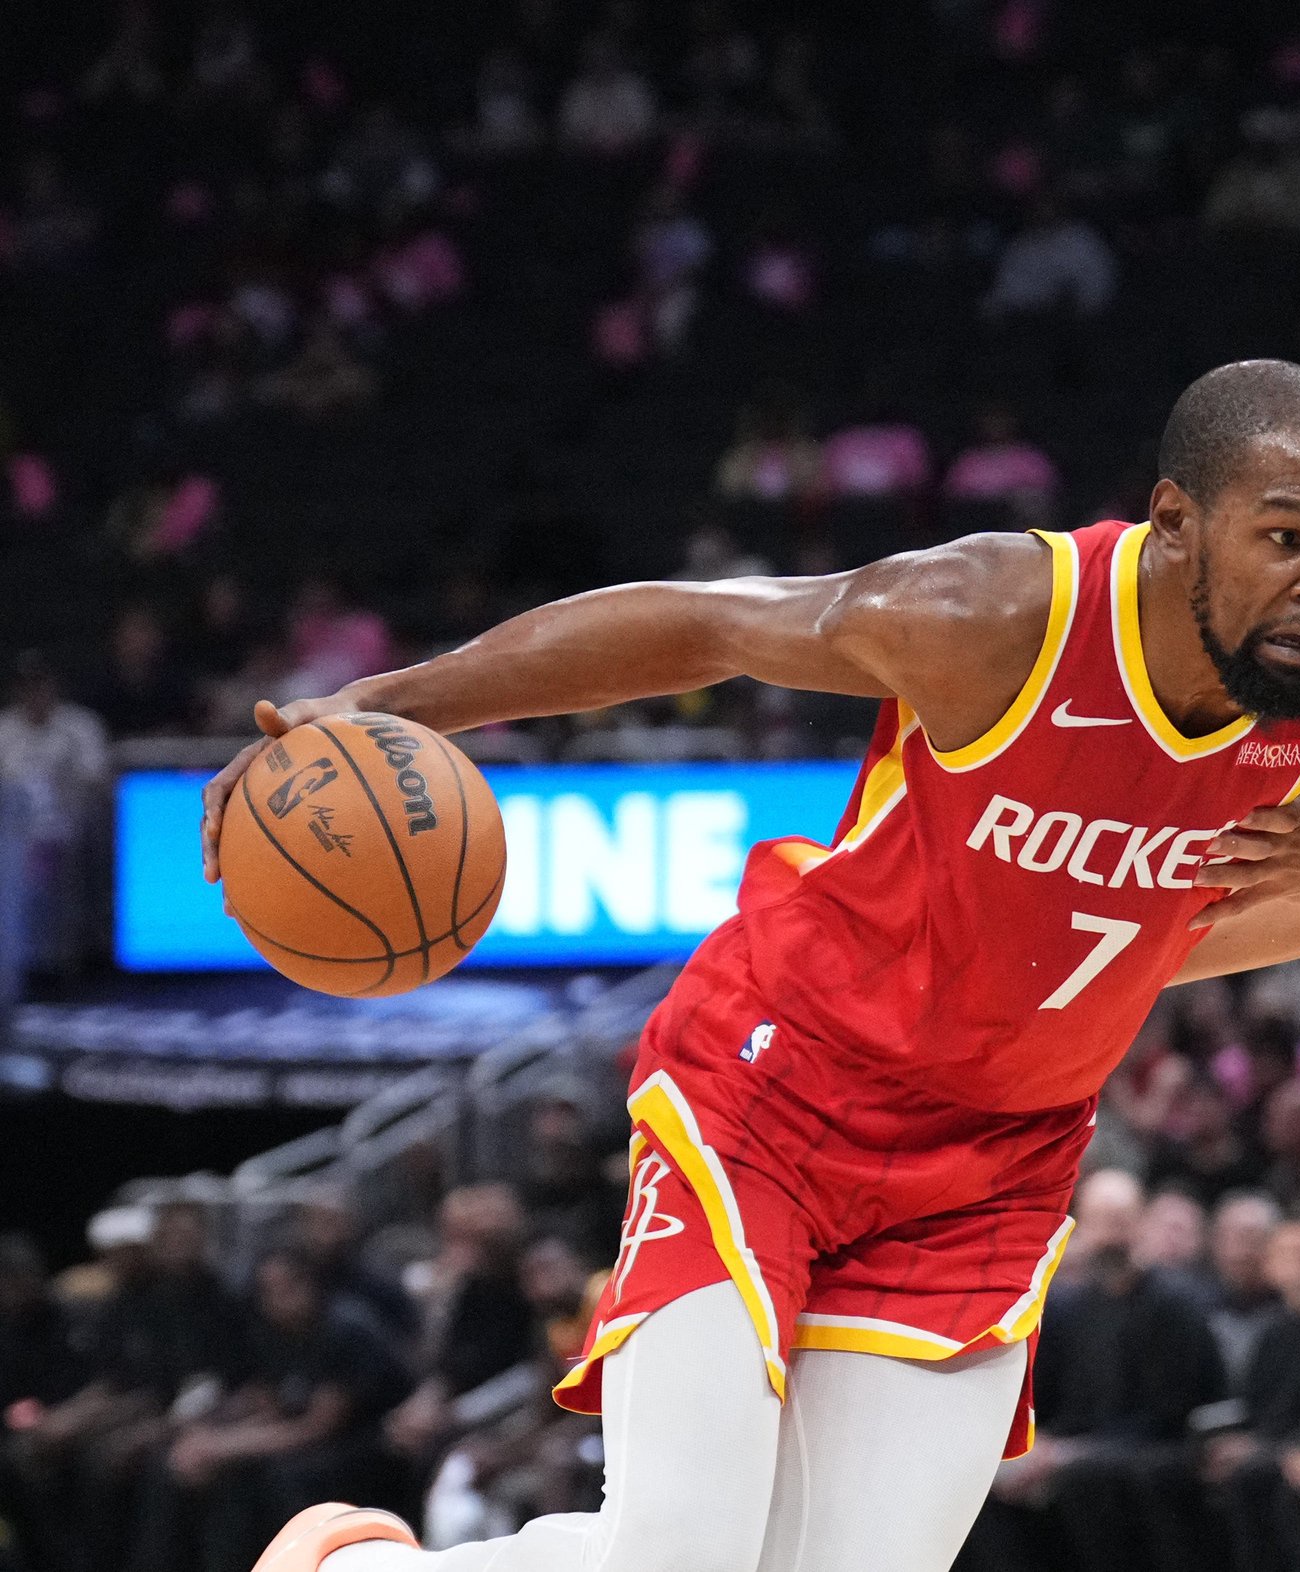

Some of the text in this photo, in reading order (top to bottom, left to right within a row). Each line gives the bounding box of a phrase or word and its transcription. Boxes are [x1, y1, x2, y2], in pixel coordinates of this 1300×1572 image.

[499, 788, 748, 936] INE
[965, 793, 1238, 889] ROCKE
[1037, 911, 1142, 1010] 7
